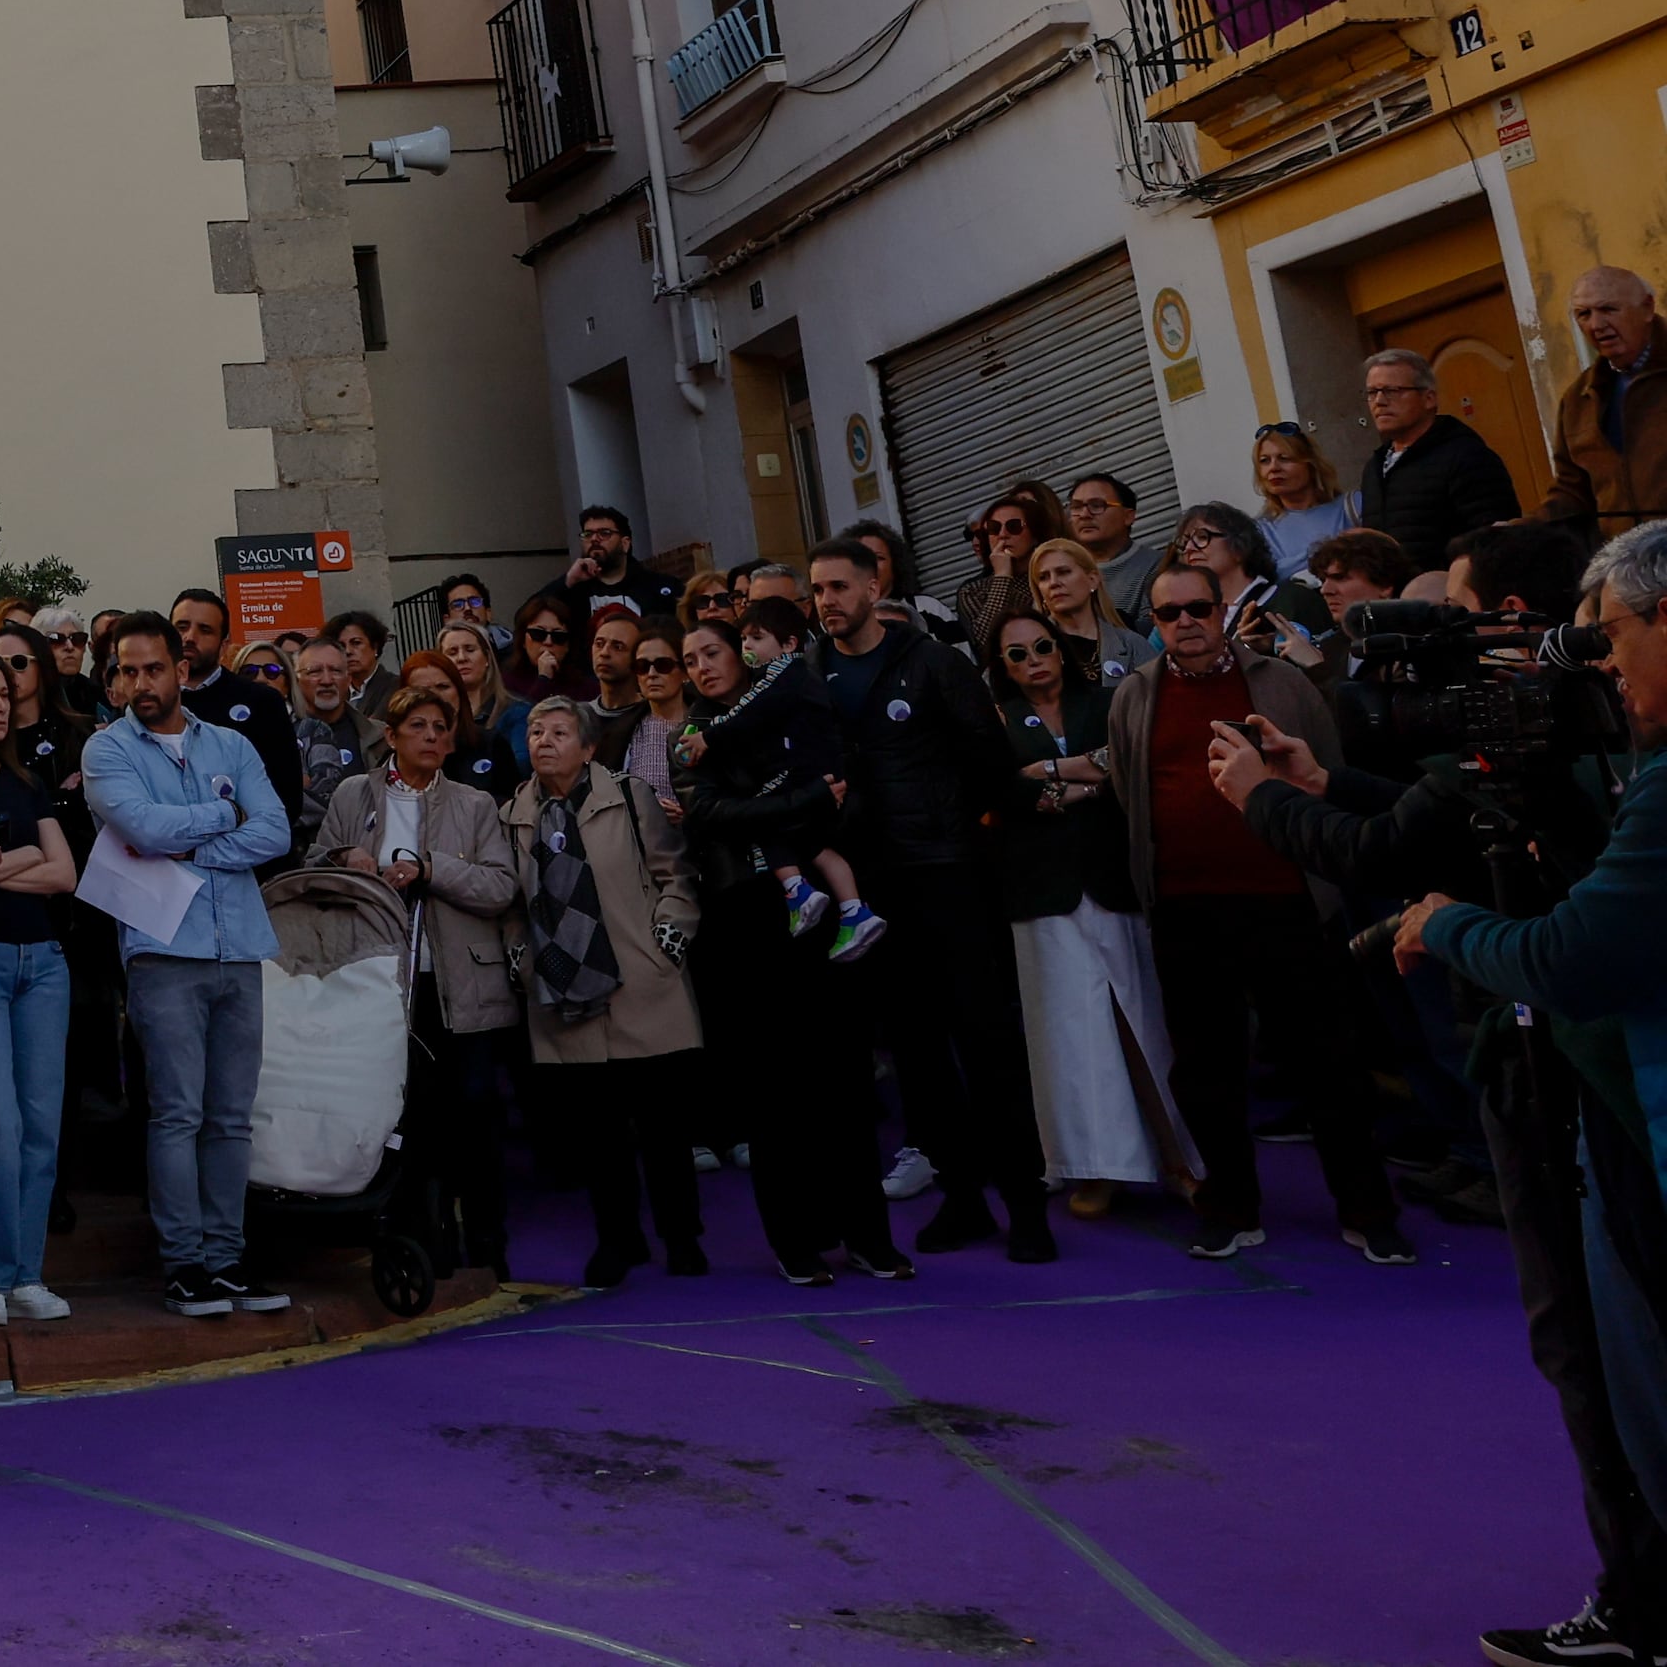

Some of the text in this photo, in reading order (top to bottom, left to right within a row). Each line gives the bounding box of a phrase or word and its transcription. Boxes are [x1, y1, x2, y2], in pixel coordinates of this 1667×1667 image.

[1455, 15, 1484, 56] 12
[241, 602, 284, 613] Ermita de
[242, 614, 275, 624] la Sang
